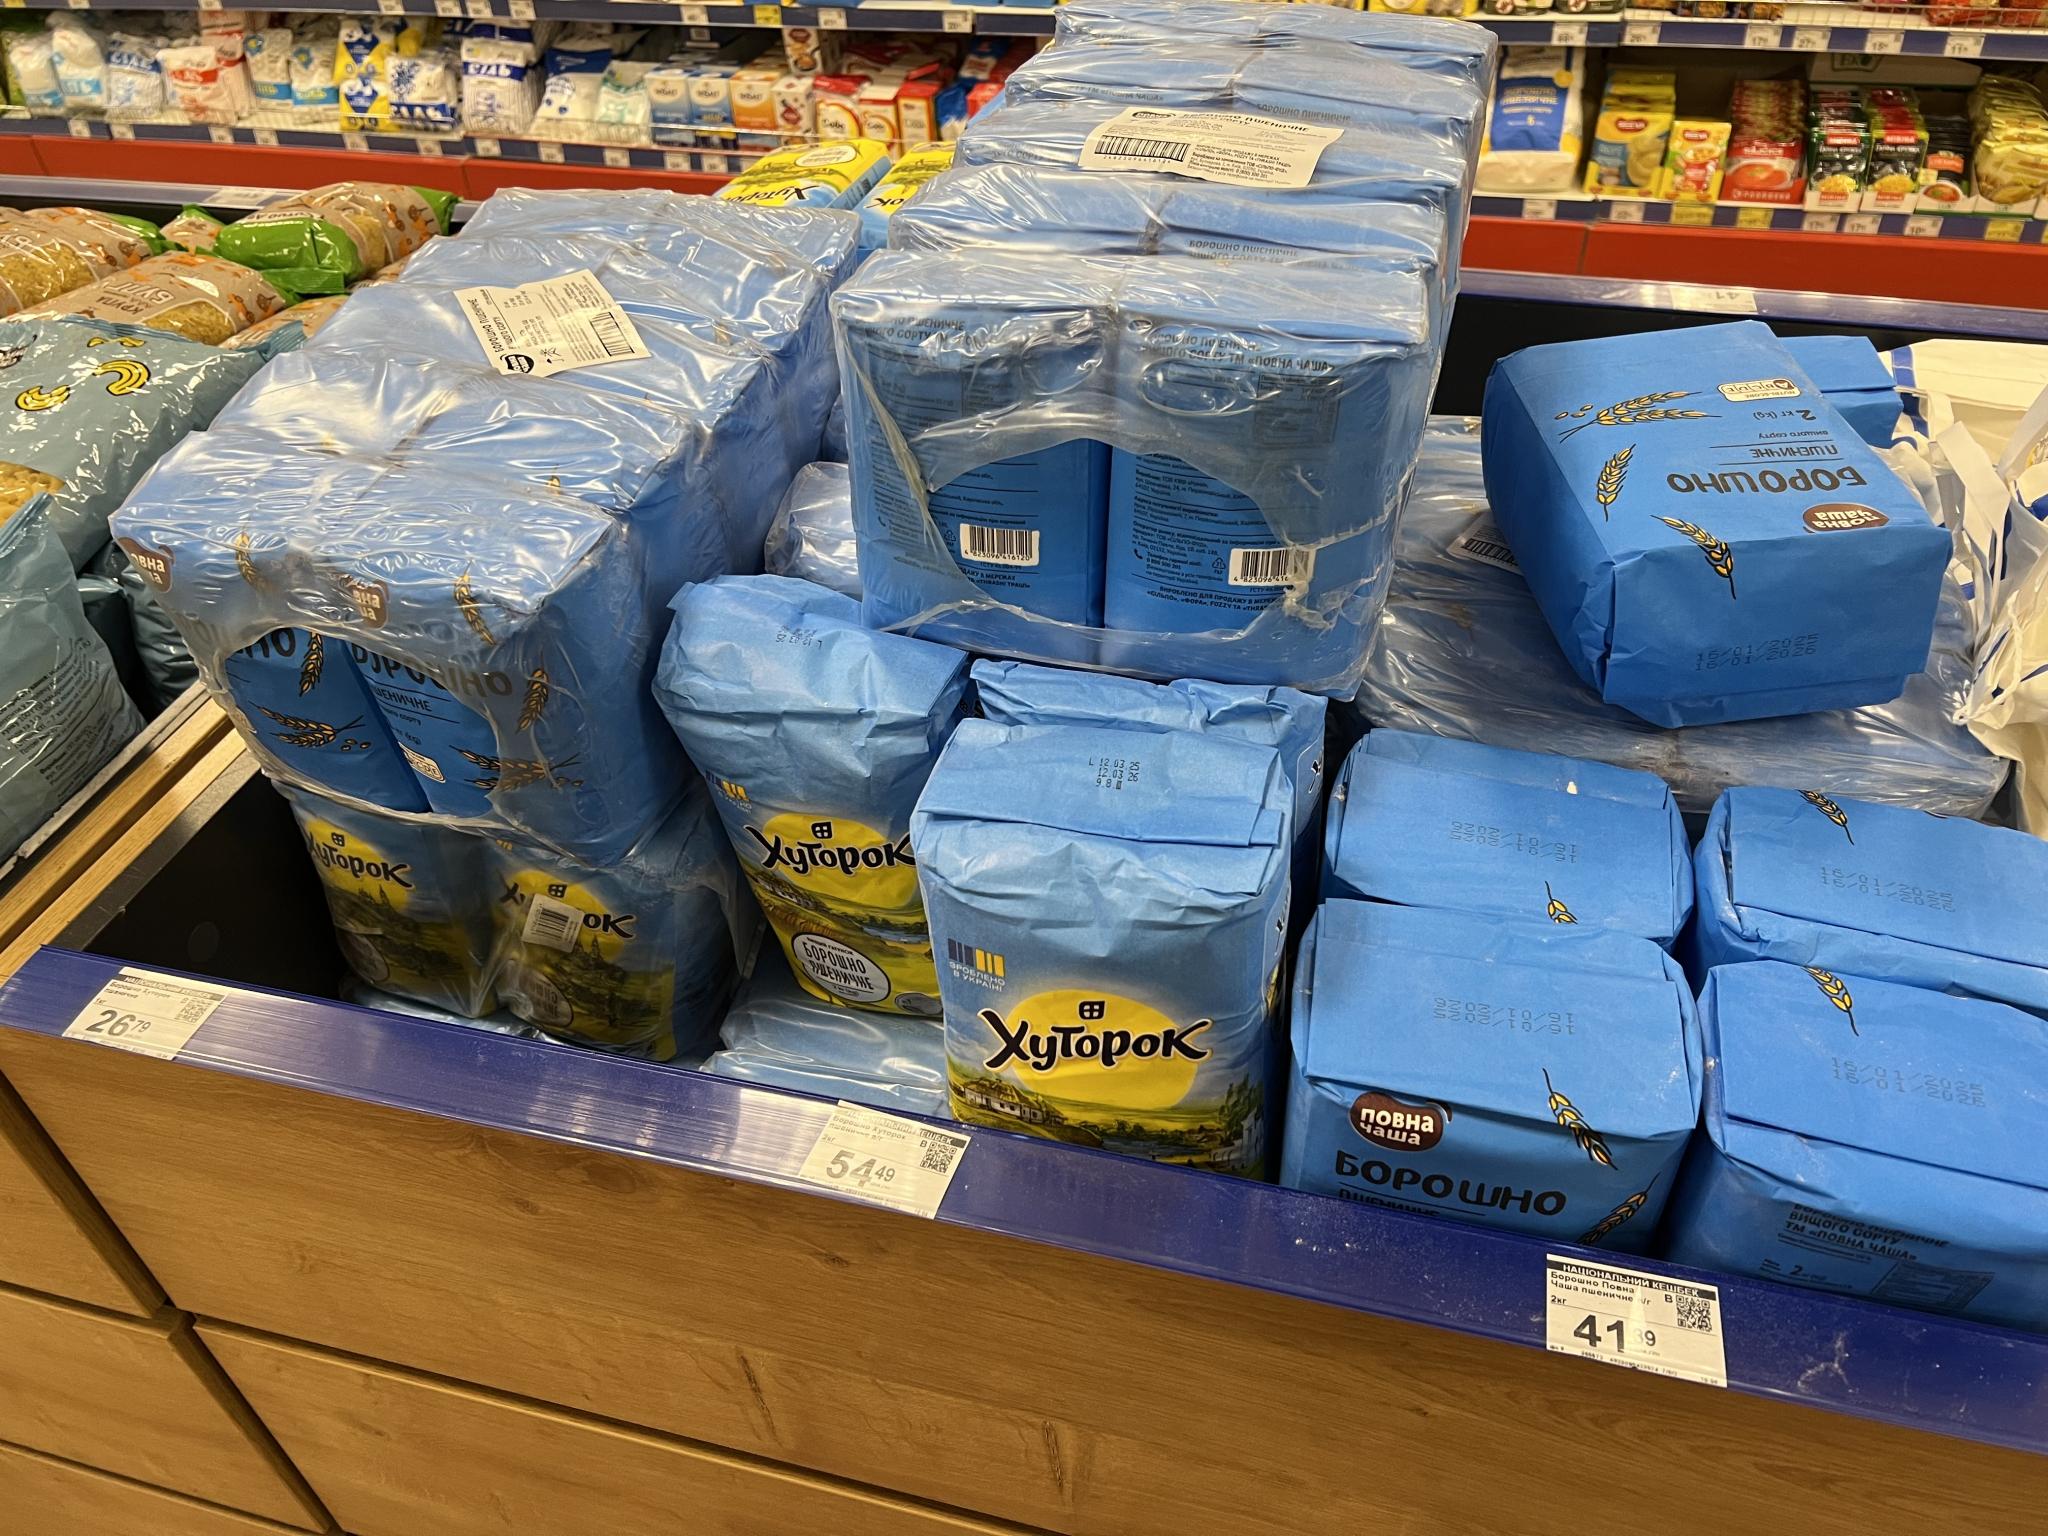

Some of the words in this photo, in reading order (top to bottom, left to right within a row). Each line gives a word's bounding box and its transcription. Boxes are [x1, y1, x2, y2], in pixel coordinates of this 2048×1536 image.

[1189, 239, 1240, 252] БОРОШНО
[1230, 354, 1245, 365] ТМ
[1753, 411, 1778, 420] (kg)
[1796, 409, 1817, 421] 2
[1758, 430, 1789, 440] сорту
[1790, 429, 1829, 438] вищого
[1751, 444, 1838, 459] ПШЕНИЧНЕ
[1666, 465, 1868, 494] БОРОШНО
[1002, 554, 1030, 562] 416120
[375, 688, 434, 712] ШЕНИЧНЕ
[744, 824, 918, 876] Хуторок
[803, 942, 867, 974] БОРОШНО
[809, 960, 875, 991] ПШЕНИЧНЕ
[949, 961, 1006, 987] ЗРОБЛЕНО
[963, 973, 1004, 992] УКРАЇНІ
[85, 1010, 137, 1037] 26
[130, 1020, 151, 1033] 79
[977, 1007, 1214, 1072] Хуторок
[821, 1134, 836, 1143] 2кг
[833, 1115, 872, 1131] Борошно
[873, 1126, 907, 1141] Хуторок
[1360, 1121, 1421, 1146] чаша
[920, 1140, 927, 1148] В
[826, 1149, 877, 1187] 54
[875, 1166, 895, 1182] 49
[1335, 1150, 1567, 1216] БОРОШНО
[1789, 1210, 1851, 1234] ВИЩОГО
[1852, 1226, 1901, 1246] СОРТУ
[1785, 1220, 1806, 1233] ТМ
[1808, 1228, 1865, 1250] «ПОВНА
[1869, 1242, 1918, 1262] ЧАША»
[1551, 1271, 1599, 1287] Борошно
[1602, 1281, 1635, 1294] Повна
[1551, 1279, 1578, 1292] Чаша
[1581, 1287, 1634, 1303] пшеничне
[1563, 1264, 1649, 1288] НАЦІОНАЛЬНИЙ
[1652, 1281, 1699, 1297] КЕШБЕК
[1551, 1295, 1567, 1305] 2кг
[1664, 1294, 1673, 1303] В
[1573, 1314, 1625, 1353] 41
